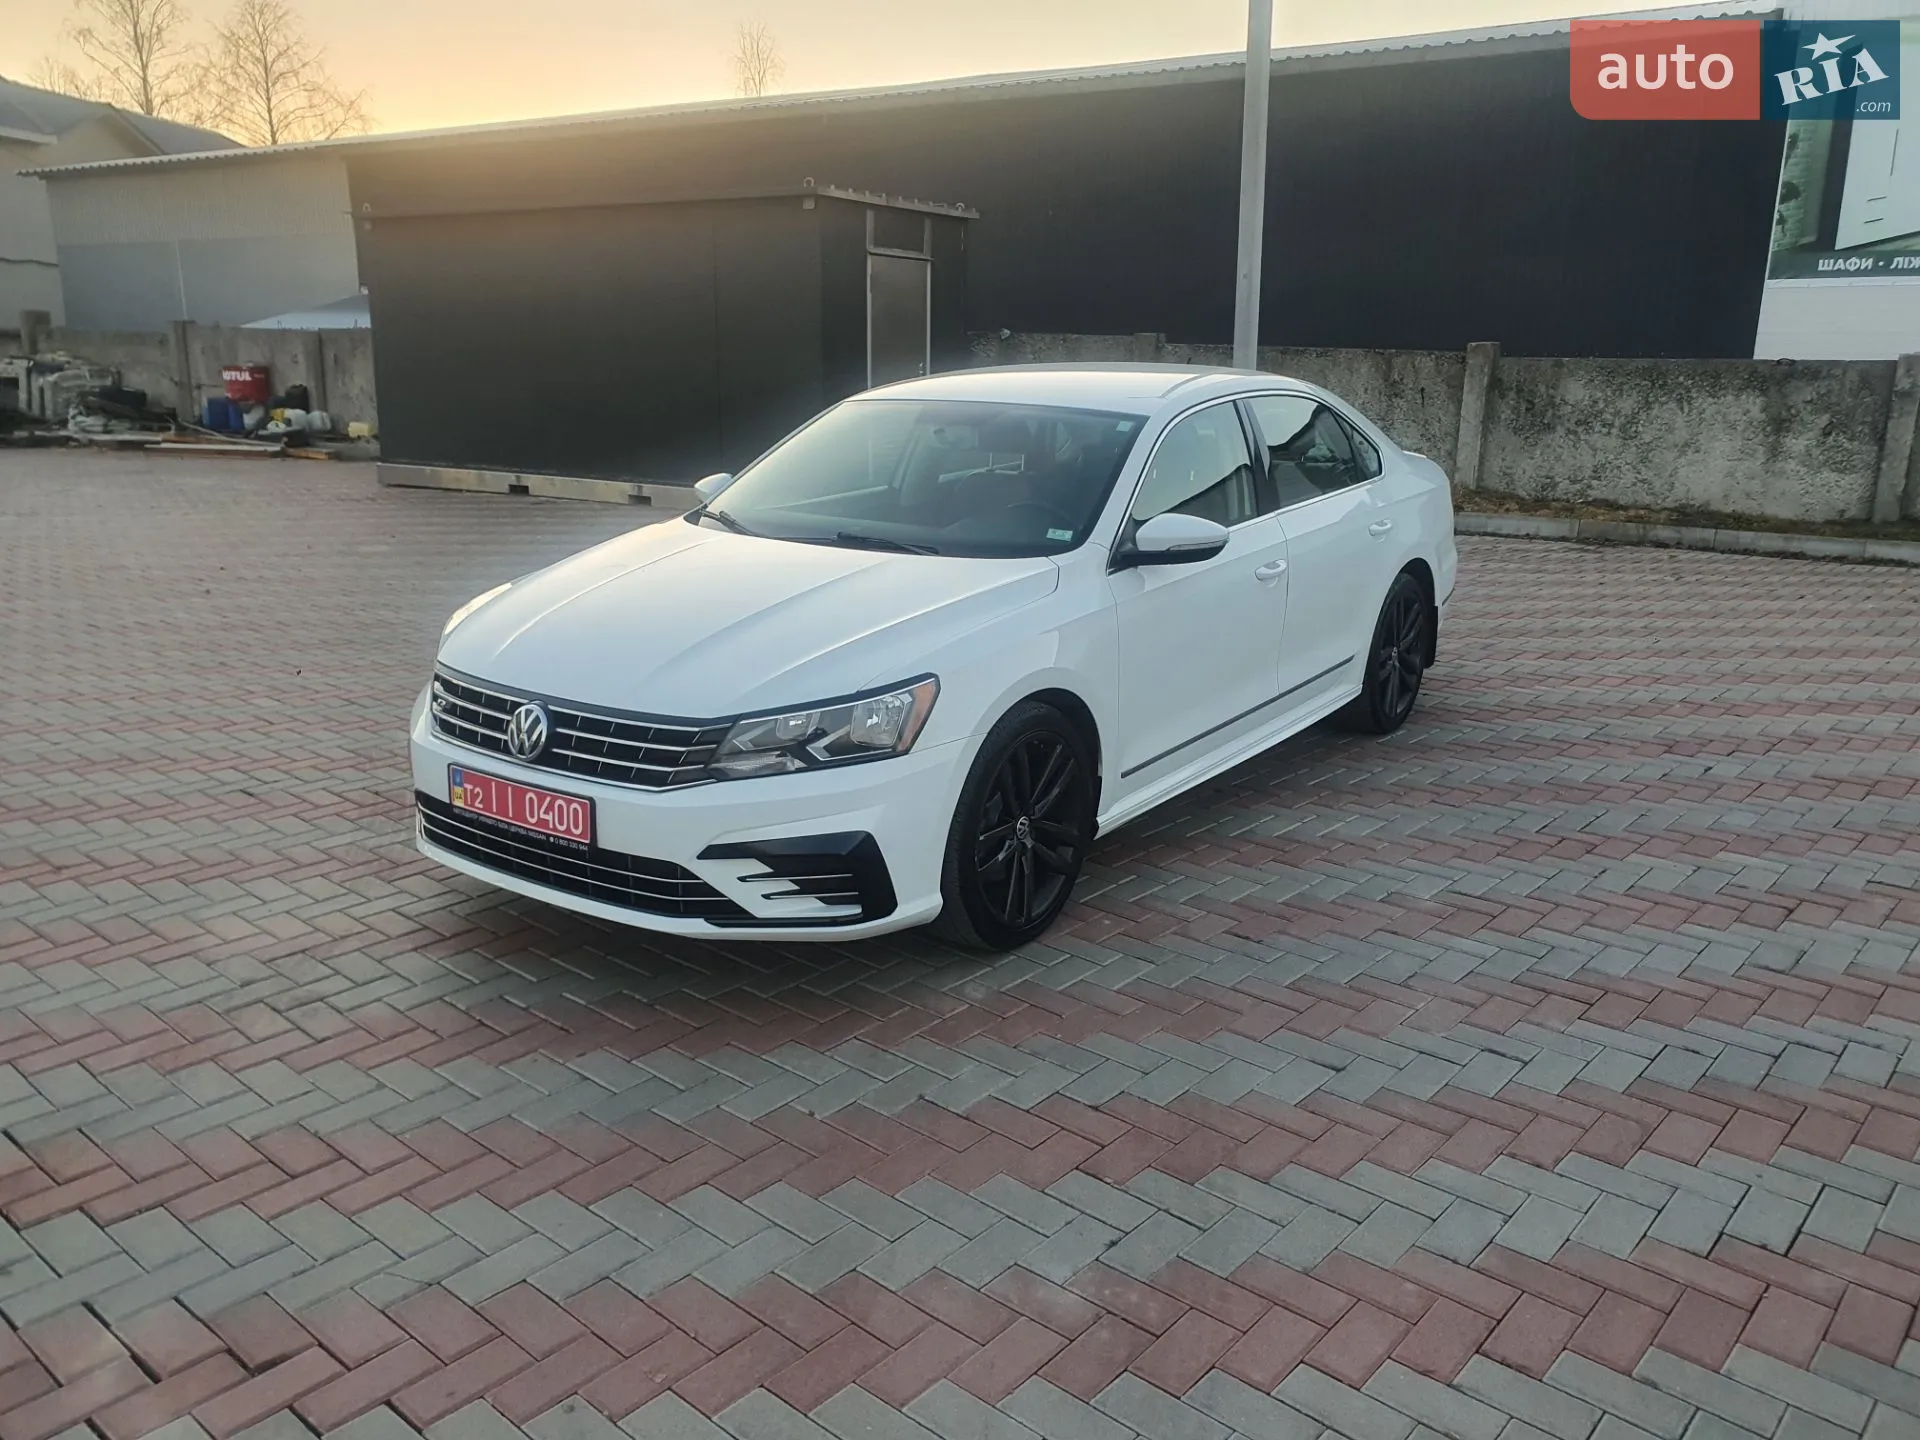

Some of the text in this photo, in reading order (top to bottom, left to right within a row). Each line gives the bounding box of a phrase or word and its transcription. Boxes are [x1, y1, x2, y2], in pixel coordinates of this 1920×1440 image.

[1817, 256, 1874, 272] ШАФИ
[464, 783, 484, 809] T2
[525, 792, 583, 836] 0400
